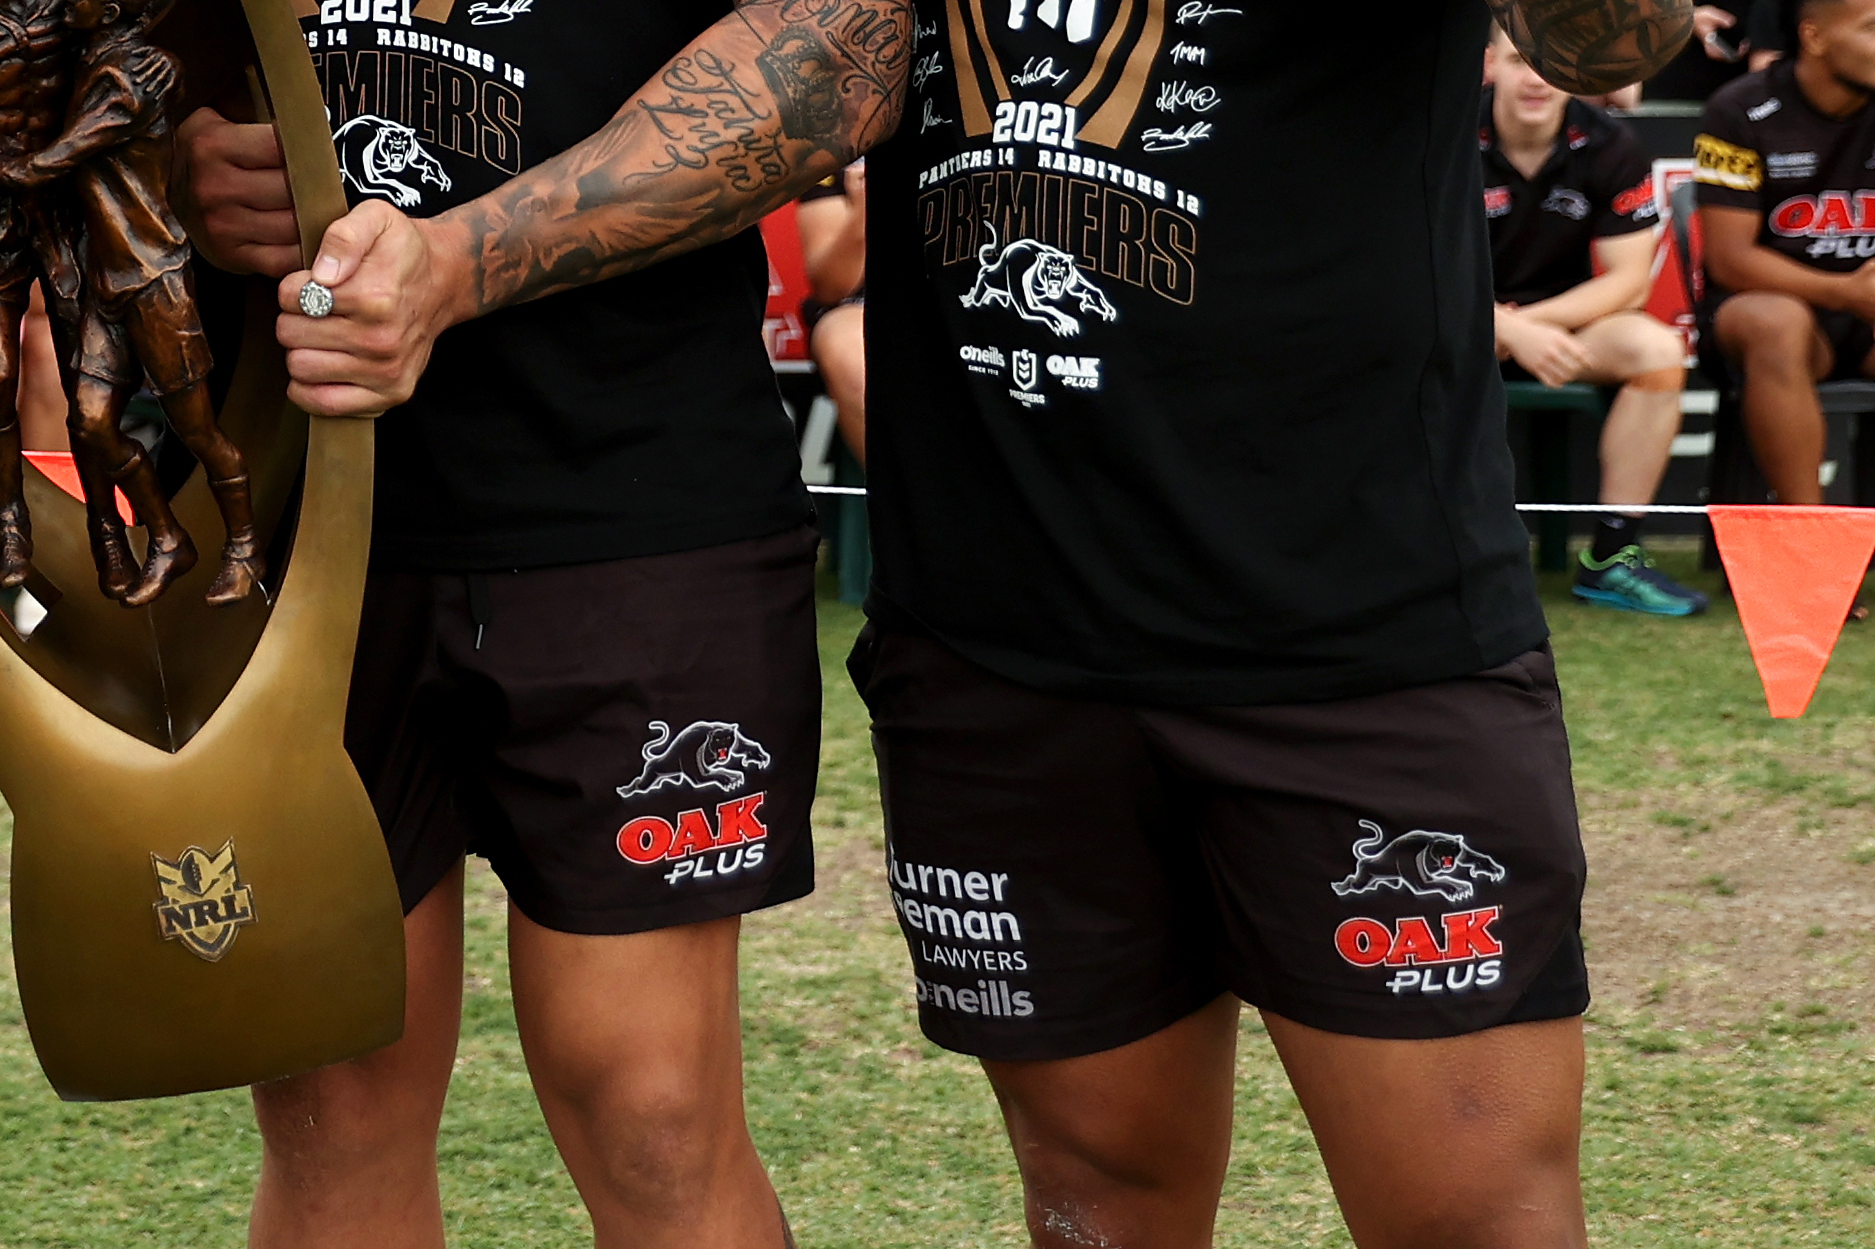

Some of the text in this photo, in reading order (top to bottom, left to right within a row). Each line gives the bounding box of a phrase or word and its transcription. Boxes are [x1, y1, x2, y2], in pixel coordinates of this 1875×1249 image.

[327, 29, 348, 46] 14
[377, 28, 495, 73] RABBITOHS
[504, 63, 525, 89] 12
[311, 50, 522, 176] MIERS
[992, 101, 1077, 150] 2021
[998, 148, 1015, 166] 14
[1038, 150, 1167, 200] RABBITOHS
[1176, 189, 1200, 217] 12
[918, 170, 1197, 306] PREMIERS
[1046, 354, 1100, 377] OAK
[1061, 376, 1099, 388] PLUS
[617, 791, 767, 864] OAK
[664, 843, 765, 884] PLUS
[163, 894, 249, 933] NRL
[1334, 906, 1503, 967] OAK
[922, 940, 1028, 971] LAWYERS
[1386, 960, 1502, 993] PLUS
